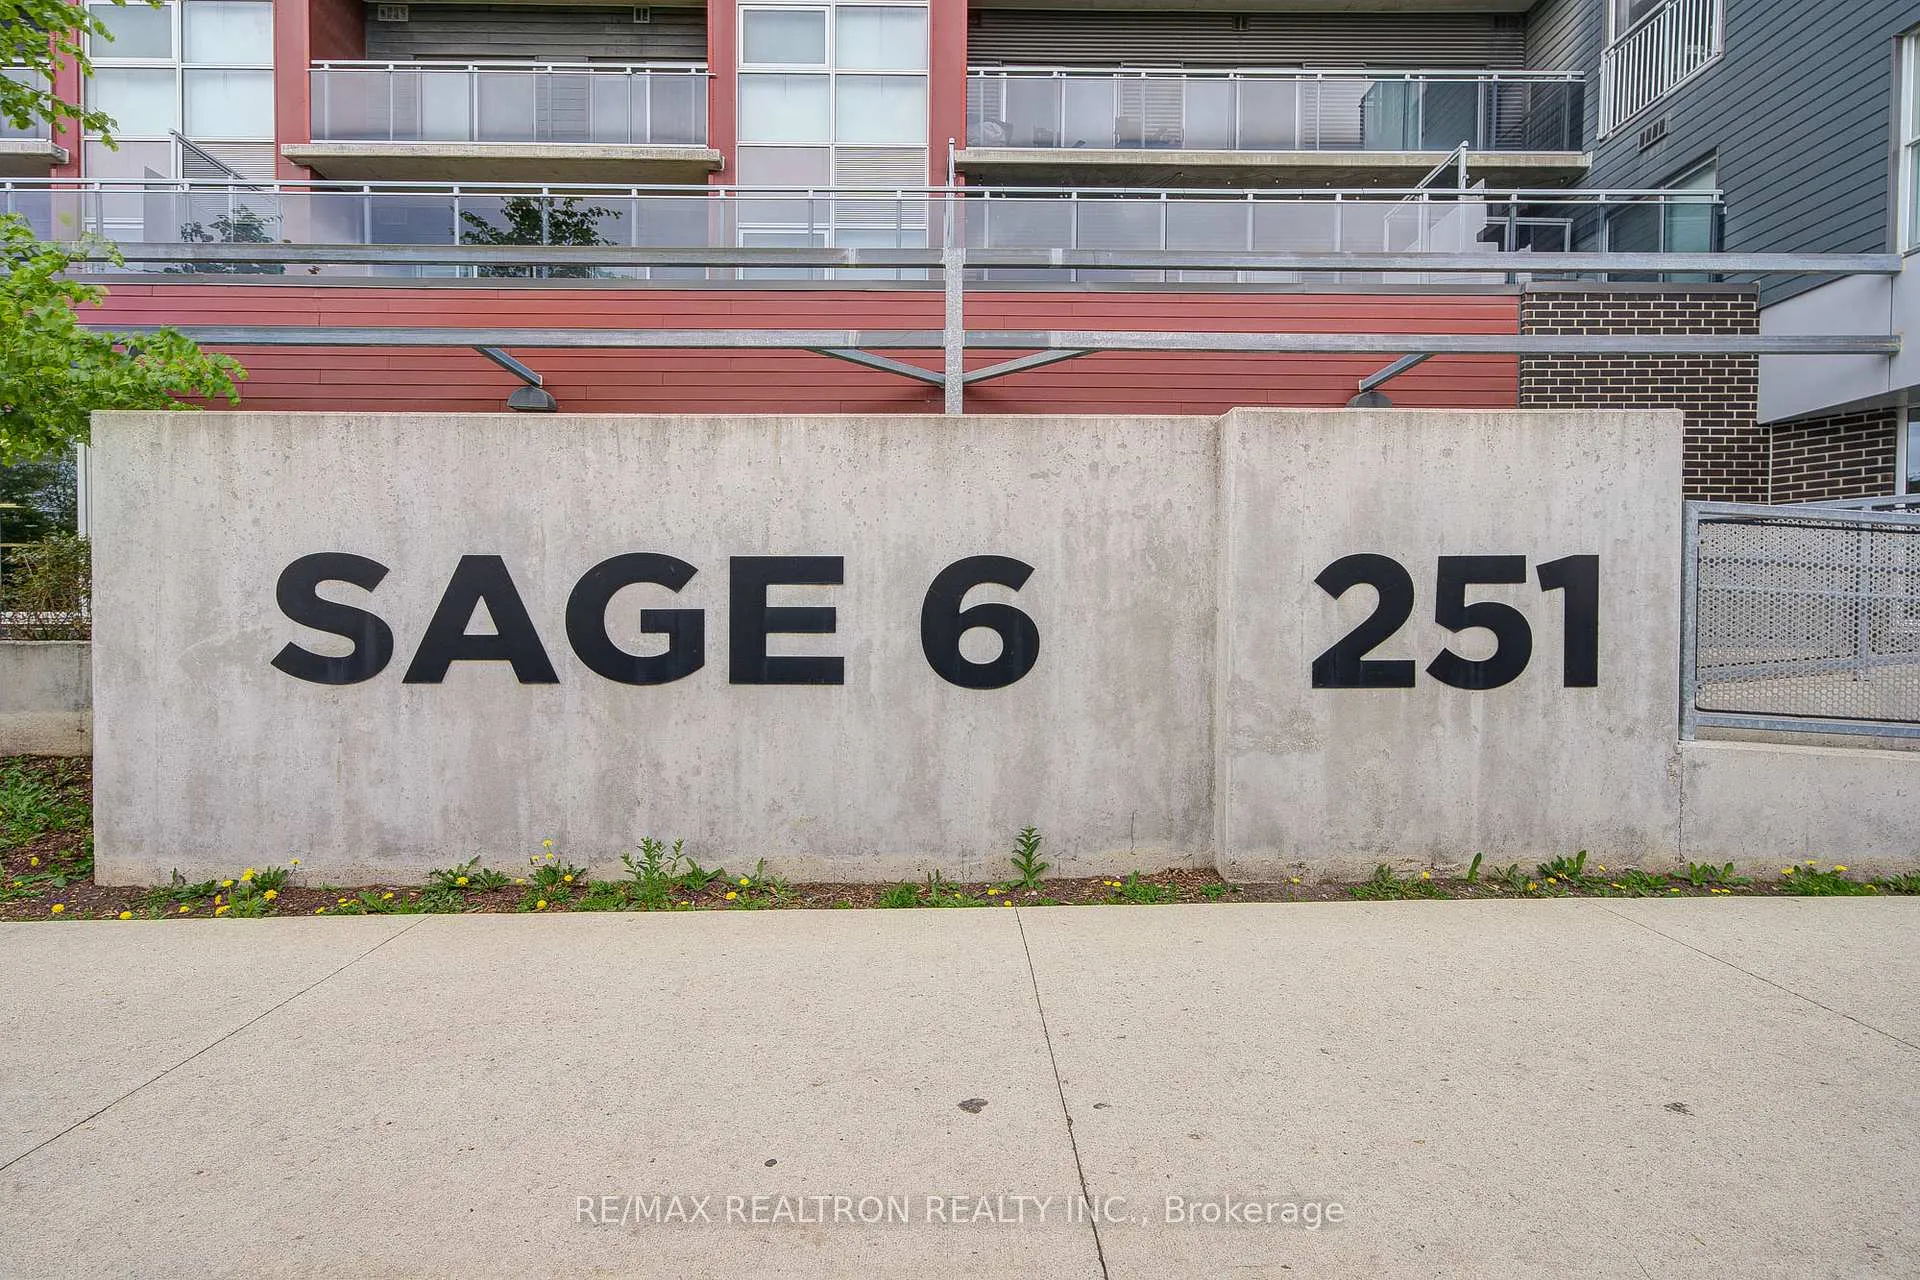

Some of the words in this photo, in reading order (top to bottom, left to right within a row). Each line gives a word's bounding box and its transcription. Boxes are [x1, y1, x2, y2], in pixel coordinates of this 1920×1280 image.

[271, 551, 845, 687] SAGE
[920, 554, 1040, 690] 6
[1312, 553, 1600, 690] 251
